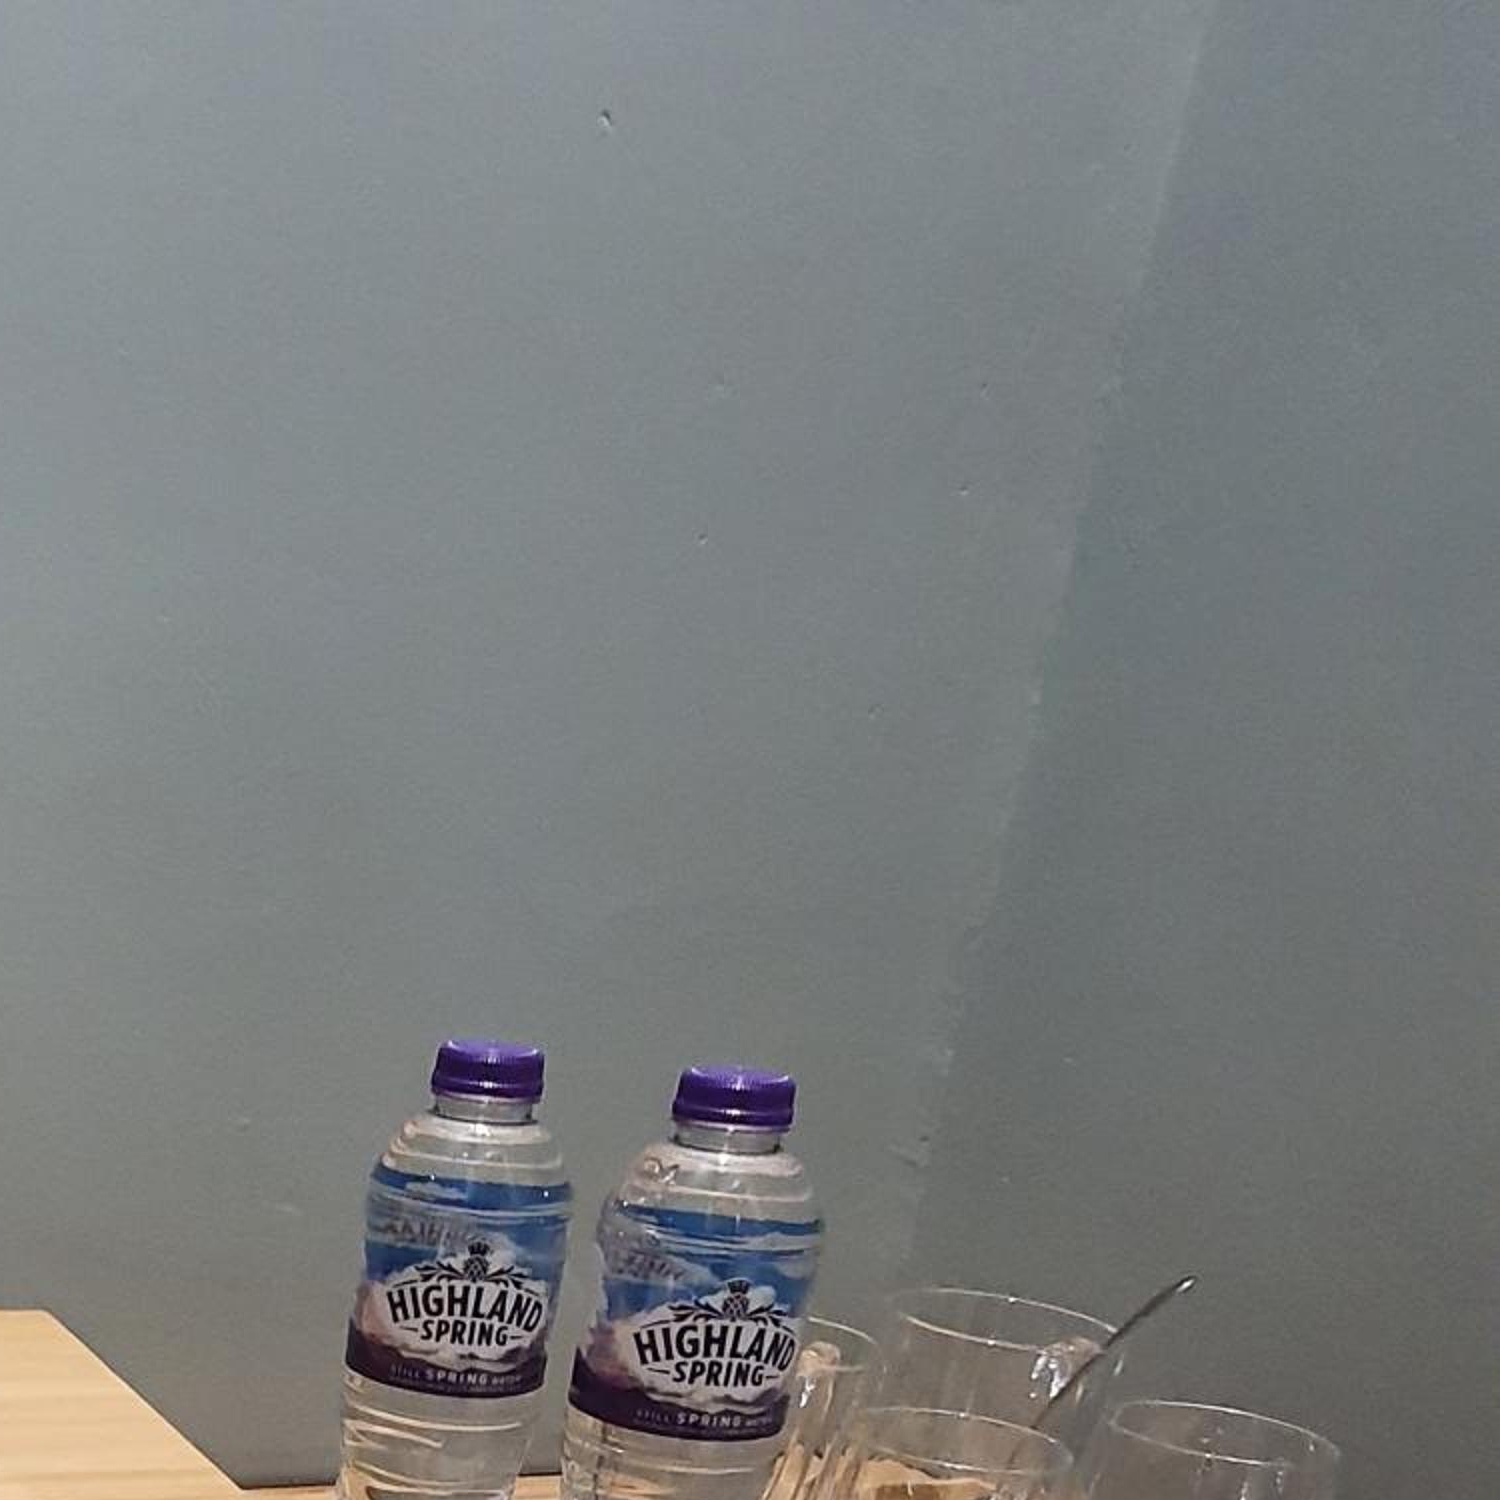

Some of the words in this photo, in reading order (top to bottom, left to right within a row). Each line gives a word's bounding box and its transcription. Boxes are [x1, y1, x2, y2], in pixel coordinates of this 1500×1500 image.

[386, 1283, 545, 1333] HIGHLAND
[420, 1319, 509, 1347] SPRING
[633, 1324, 796, 1372] HIGHLAND
[672, 1360, 766, 1388] SPRING
[676, 1411, 742, 1428] SPRING
